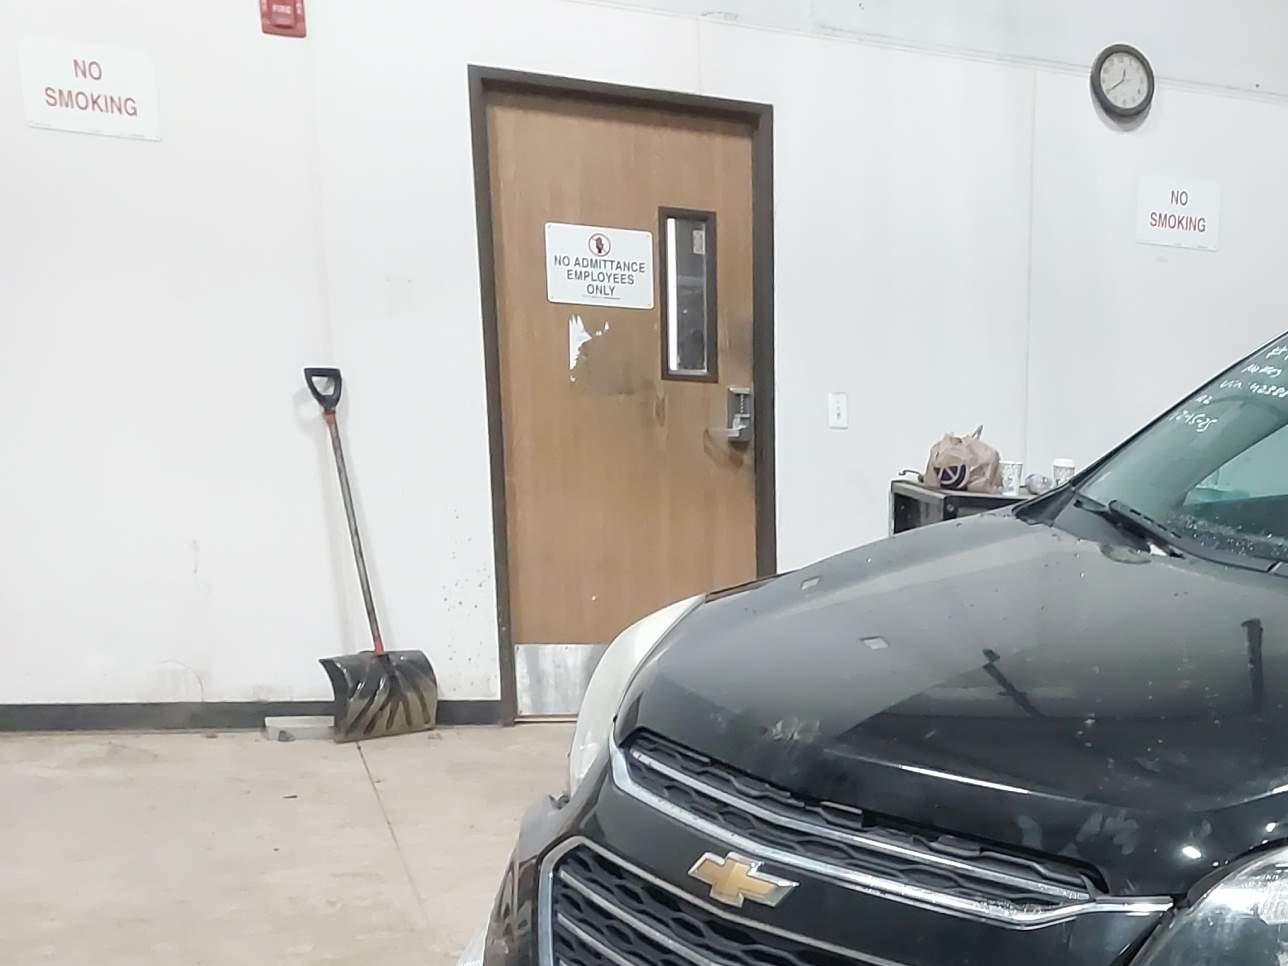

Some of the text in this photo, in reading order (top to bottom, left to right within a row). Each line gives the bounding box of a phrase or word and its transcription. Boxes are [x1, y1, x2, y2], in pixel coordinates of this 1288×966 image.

[73, 59, 102, 80] NO
[44, 86, 138, 117] SMOKING
[1170, 190, 1188, 206] NO
[1149, 211, 1206, 232] SMOKING
[554, 255, 646, 273] NO ADMITTANCE
[566, 269, 635, 285] EMPLOYEES
[586, 283, 616, 296] ONLY
